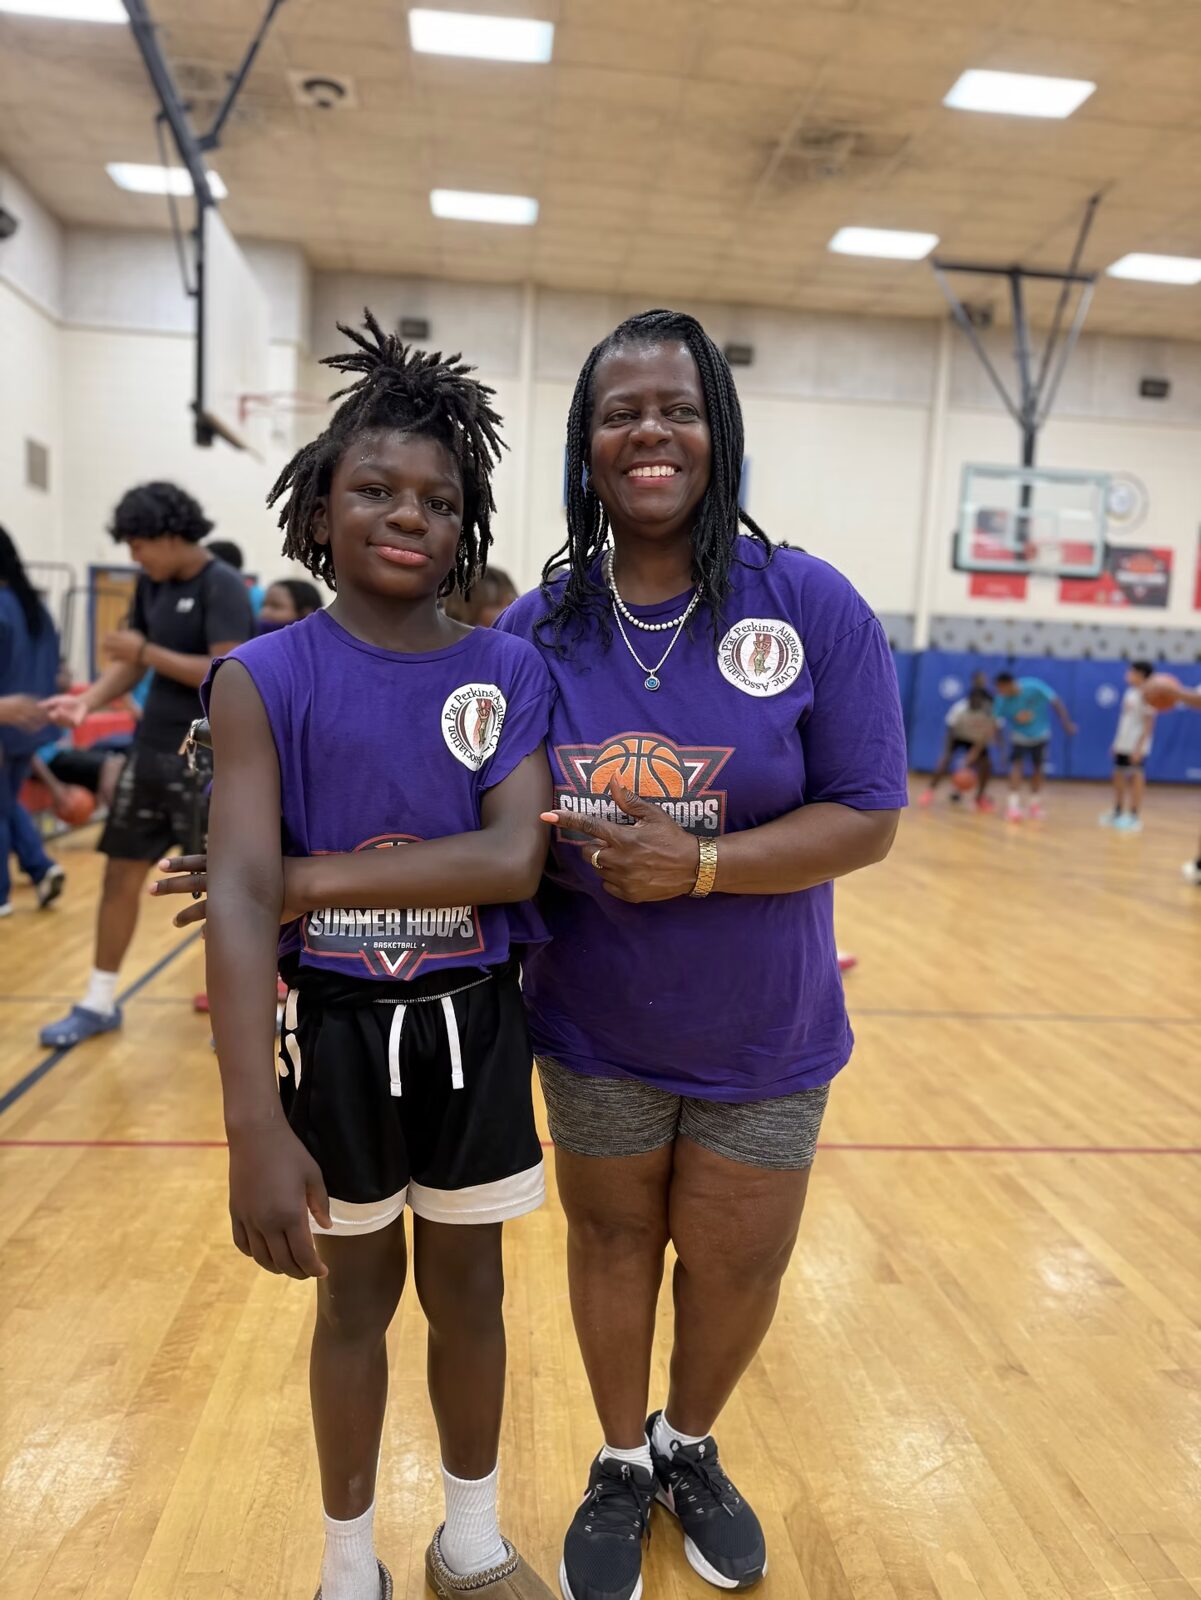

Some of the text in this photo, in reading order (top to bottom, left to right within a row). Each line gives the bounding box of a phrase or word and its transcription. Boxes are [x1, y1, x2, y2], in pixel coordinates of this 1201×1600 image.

[721, 634, 737, 652] Pat
[723, 654, 770, 692] Association
[771, 665, 798, 687] Civic
[444, 703, 459, 722] Pat
[559, 794, 719, 830] SUMME OOPS
[307, 905, 475, 939] SUMMER HOOPS
[373, 941, 418, 949] BASKETBALL
